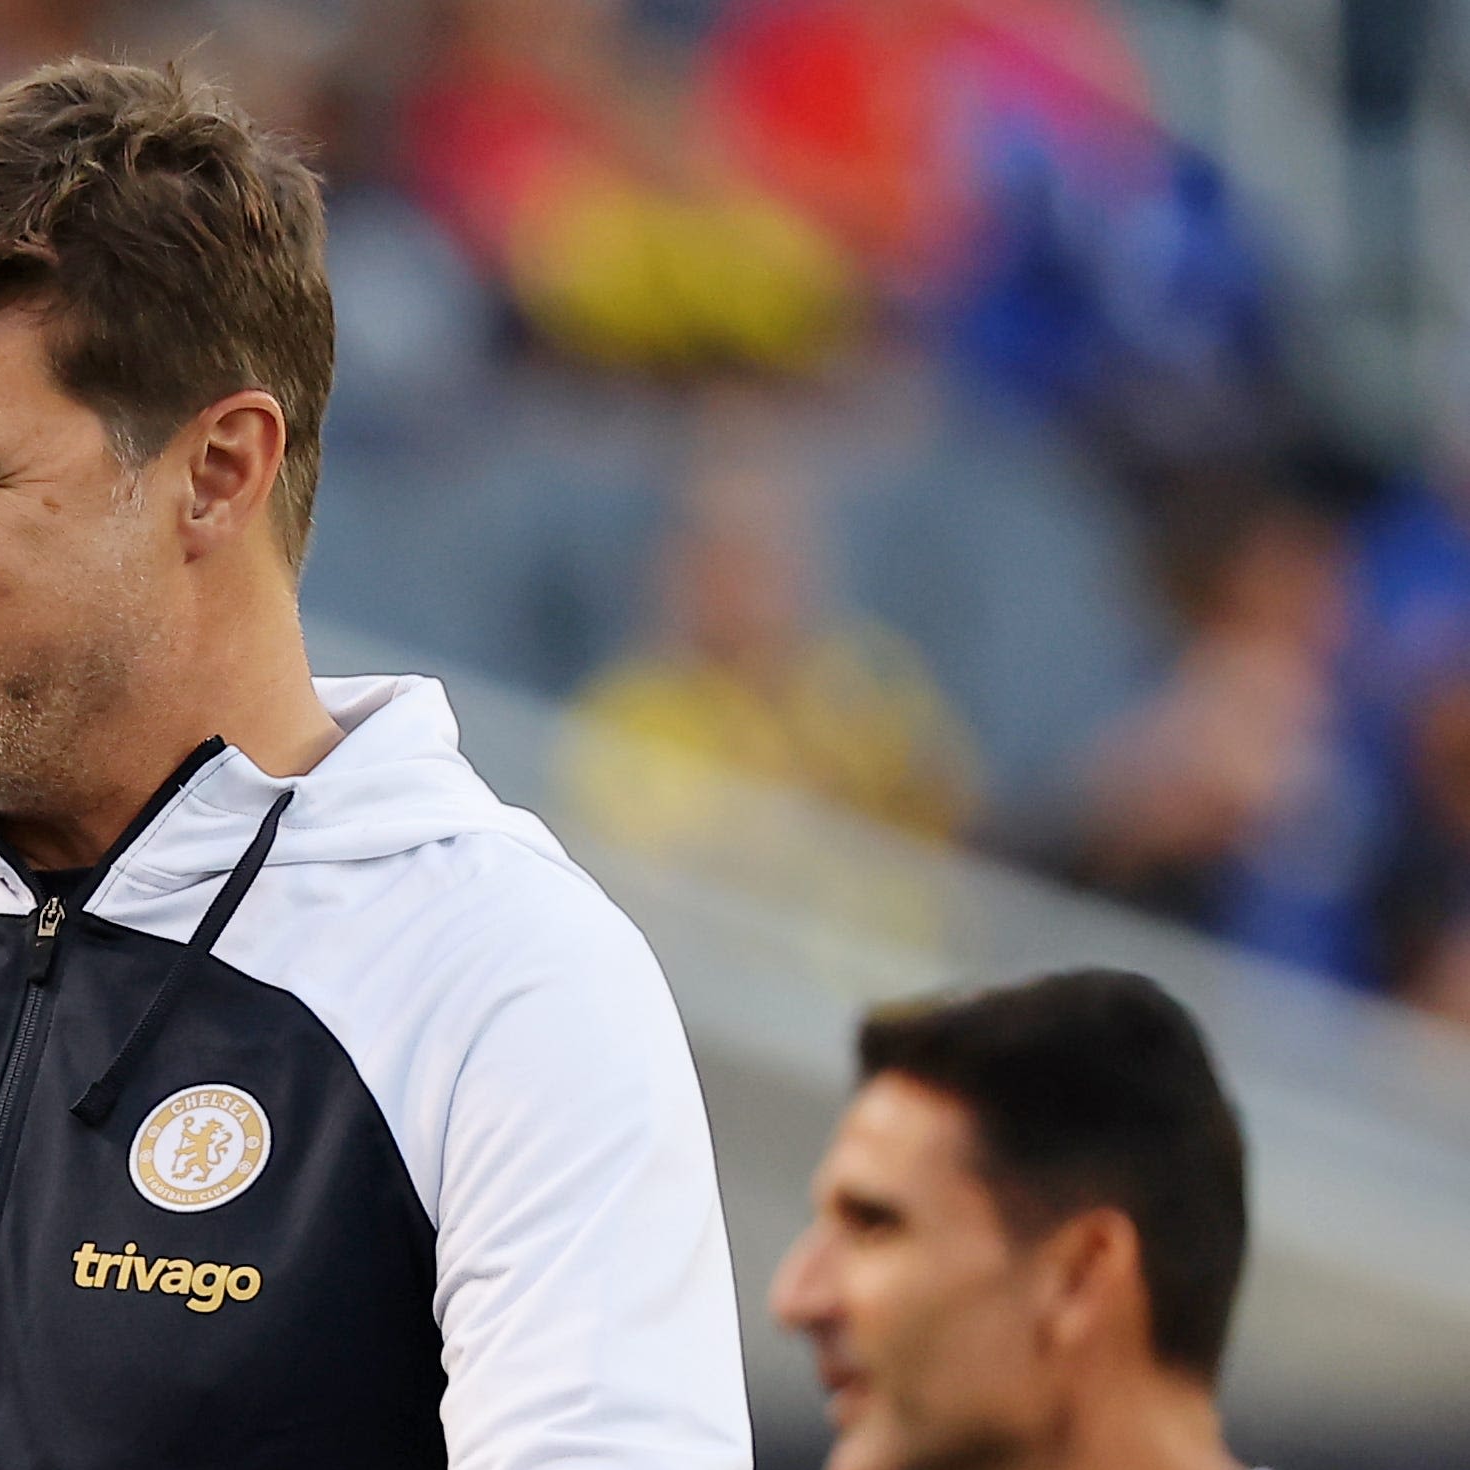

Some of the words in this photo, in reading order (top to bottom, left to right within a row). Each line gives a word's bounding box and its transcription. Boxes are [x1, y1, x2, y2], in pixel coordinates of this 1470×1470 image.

[170, 1093, 250, 1122] CHELSEA
[146, 1176, 194, 1201] FOOTBALL
[200, 1184, 229, 1200] CLUB
[73, 1242, 262, 1313] trivago
